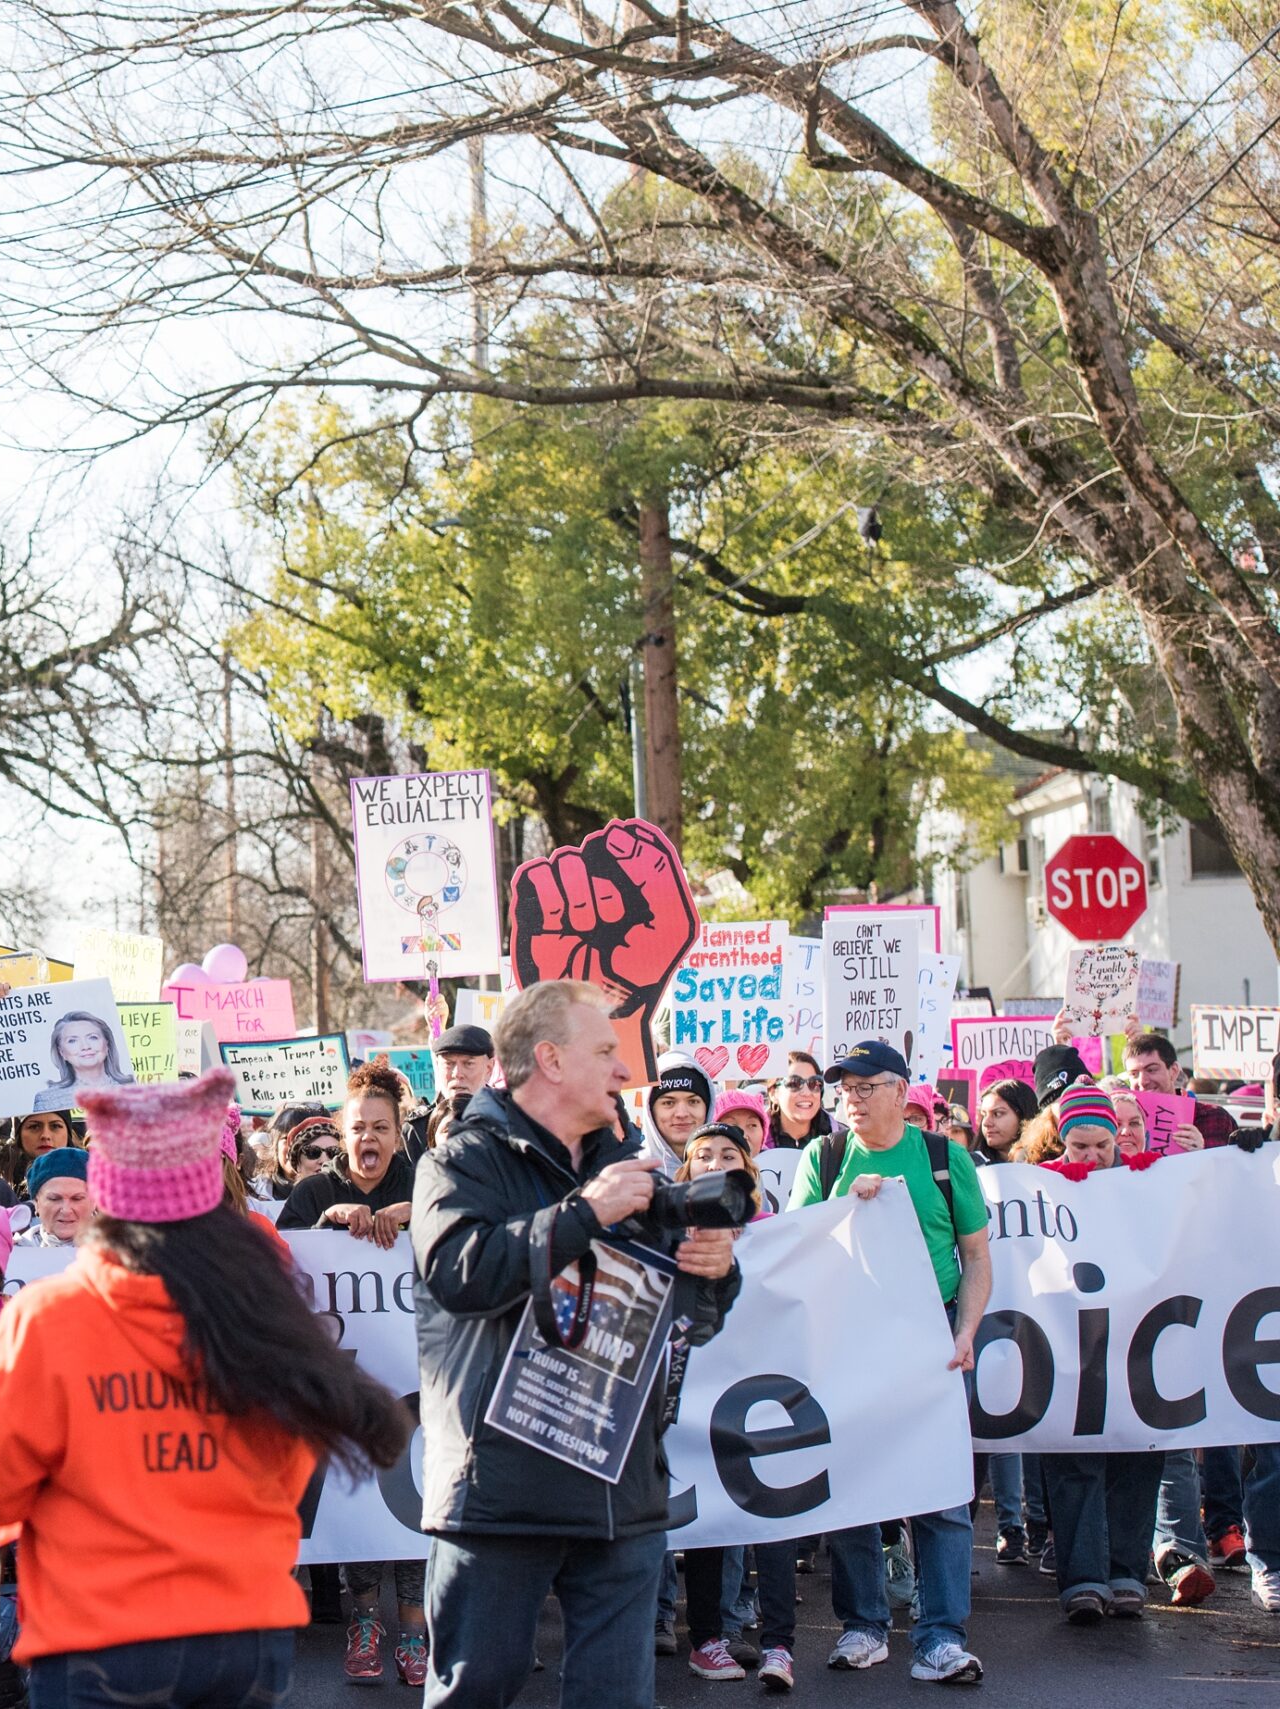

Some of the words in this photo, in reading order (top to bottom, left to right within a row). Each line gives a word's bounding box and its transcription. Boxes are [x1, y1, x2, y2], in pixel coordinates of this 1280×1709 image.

[355, 779, 391, 802] WE
[405, 773, 485, 800] EXPECT
[366, 795, 484, 827] EQUALITY
[1051, 867, 1140, 909] STOP
[702, 923, 771, 947] lanned
[856, 924, 882, 939] CAN'T
[679, 945, 782, 969] arenthood
[833, 939, 873, 957] BELIEVE
[883, 938, 902, 954] WE
[843, 956, 899, 980] STILL
[1089, 961, 1127, 979] Equality
[674, 964, 783, 1002] Saved
[27, 992, 52, 1007] ARE
[168, 986, 195, 1019] I
[205, 987, 264, 1010] MARCH
[850, 990, 876, 1005] HAVE
[884, 988, 895, 1004] TO
[236, 1012, 264, 1032] FOR
[722, 1005, 784, 1043] Life
[846, 1008, 902, 1031] PROTEST
[130, 1035, 152, 1047] TO
[1201, 1014, 1280, 1052] IMPE
[229, 1050, 273, 1066] Impeach
[242, 1070, 286, 1082] Before
[294, 1066, 311, 1076] his
[320, 1064, 338, 1076] ego
[251, 1088, 275, 1101] Kills
[279, 1090, 295, 1100] us
[988, 1190, 1078, 1242] nto
[527, 1347, 567, 1376] TRUMP
[566, 1367, 580, 1382] IS
[505, 1406, 531, 1426] NOT
[529, 1418, 549, 1436] MY
[546, 1426, 610, 1465] PRESIDENT
[143, 1431, 218, 1473] LEAD
